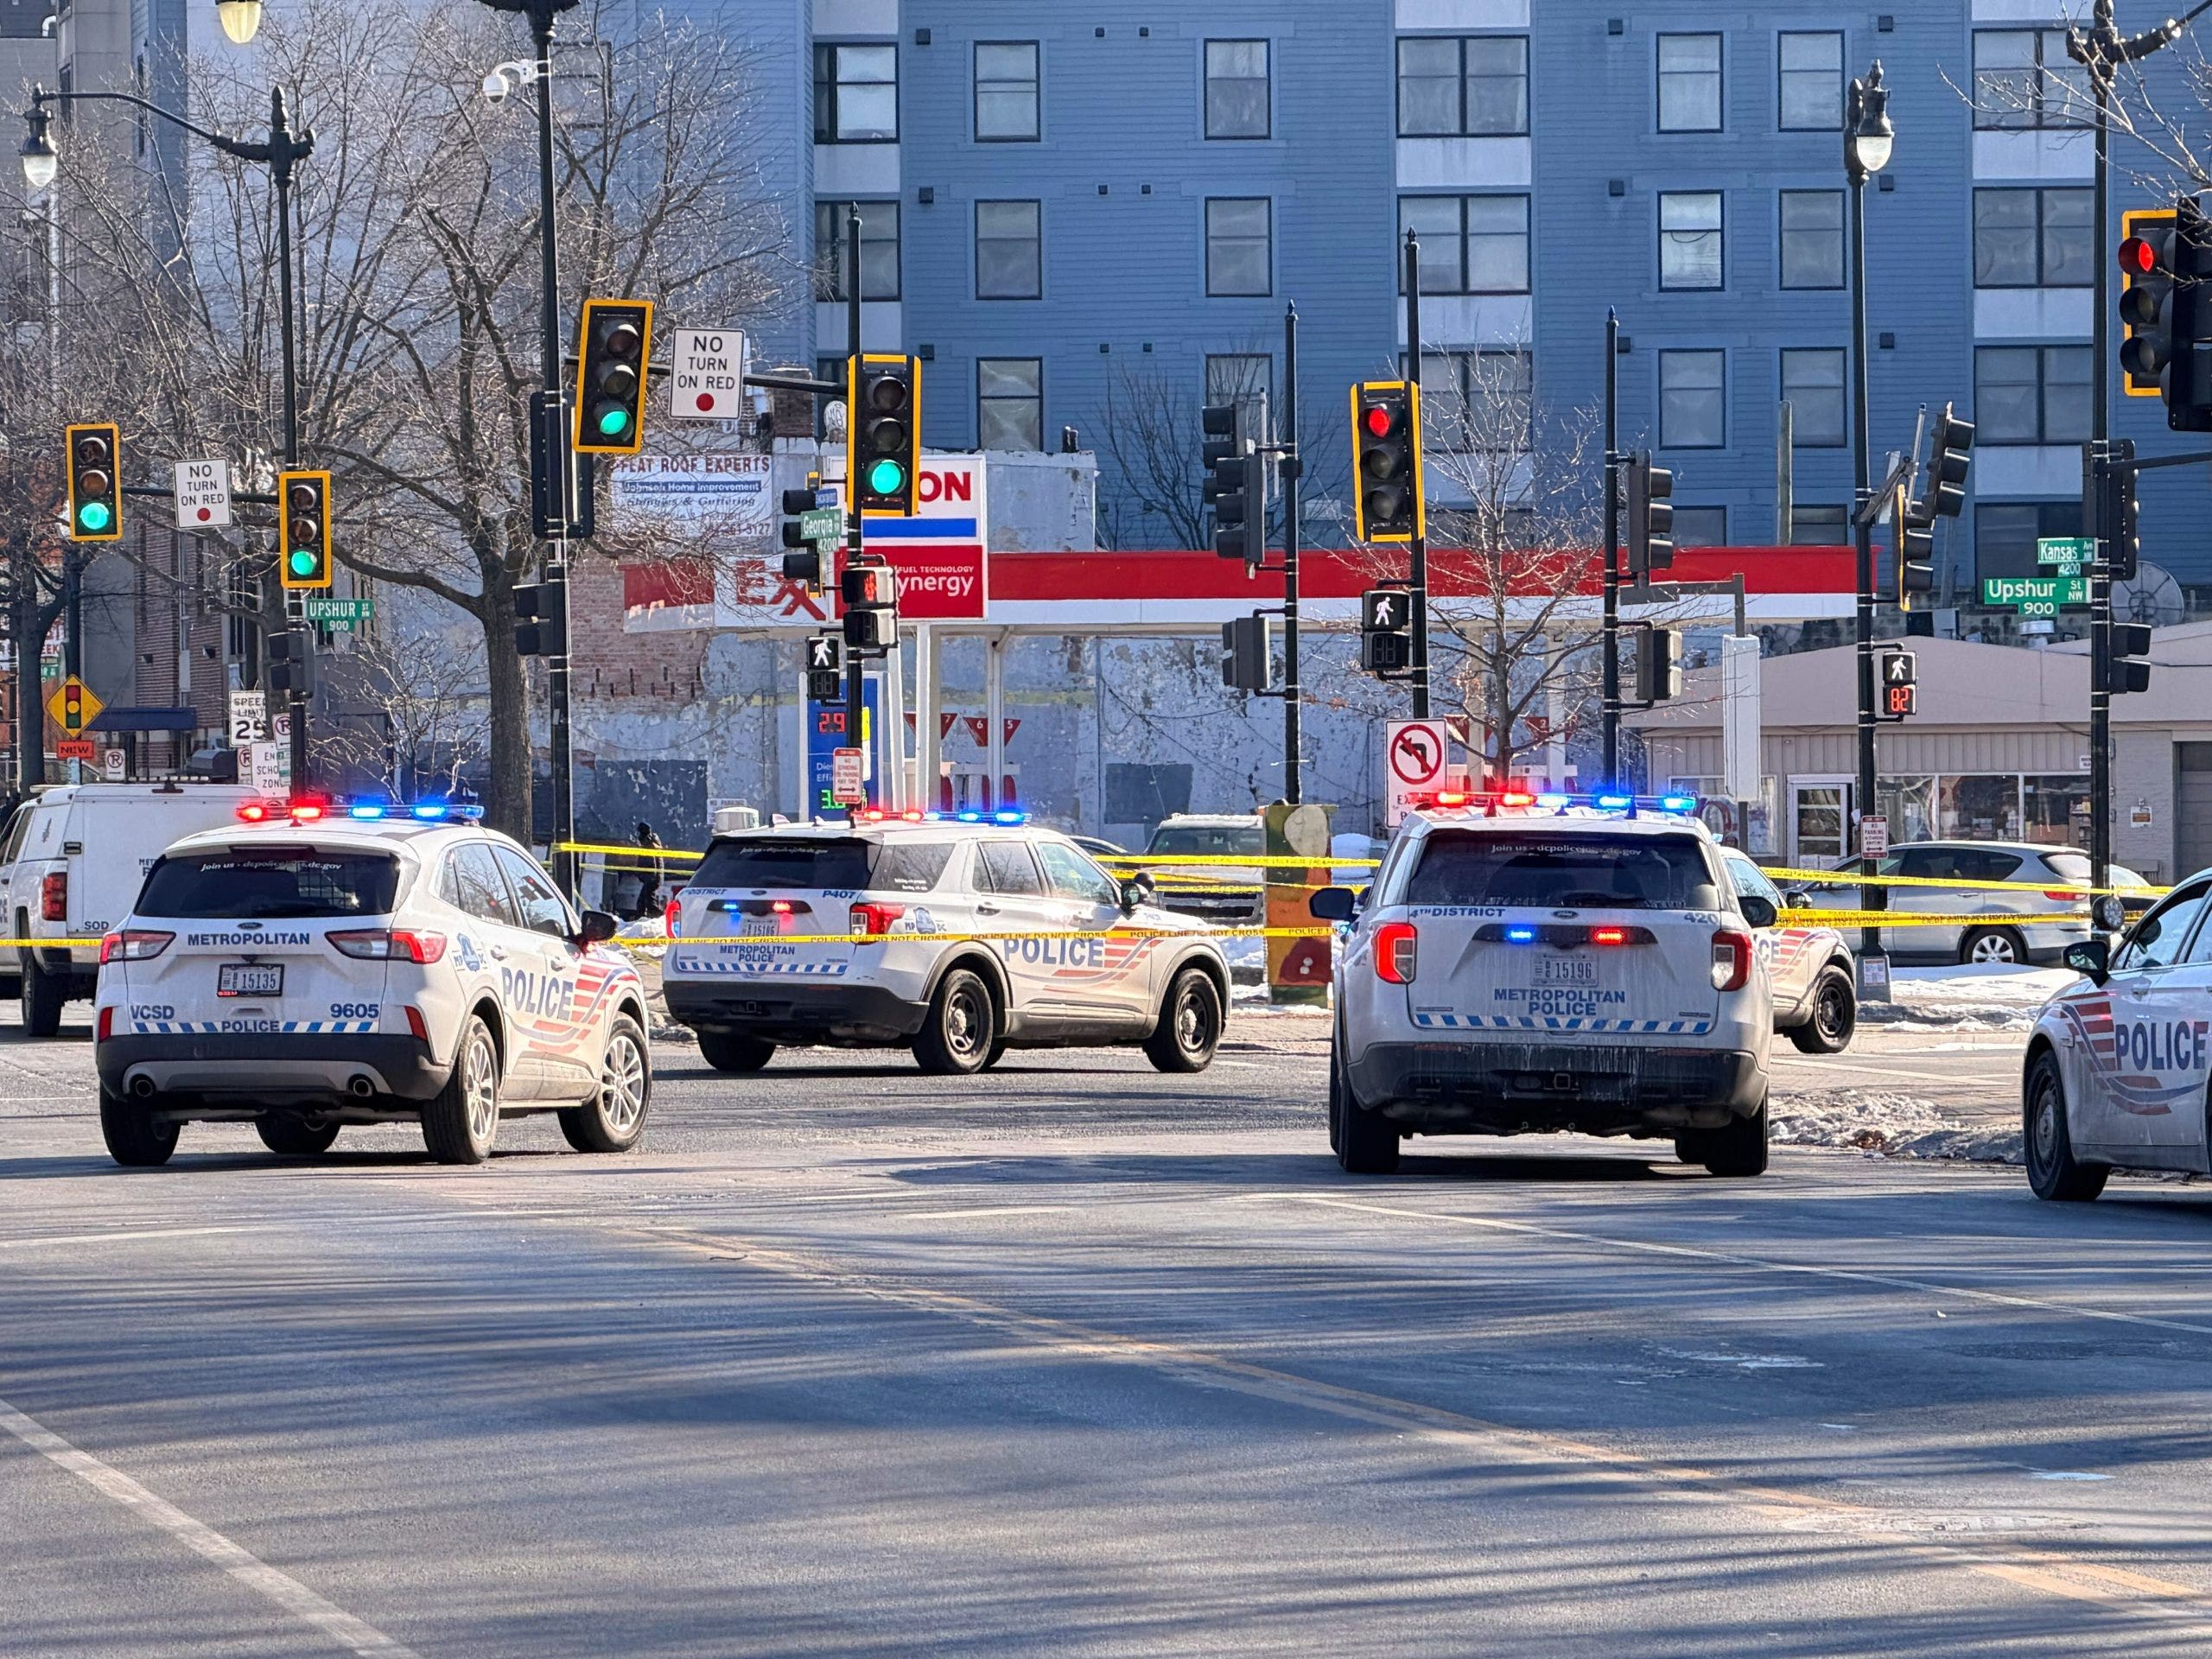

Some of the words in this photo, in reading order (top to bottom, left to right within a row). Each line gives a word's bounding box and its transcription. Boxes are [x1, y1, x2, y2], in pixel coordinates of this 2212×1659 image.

[693, 336, 723, 353] NO
[687, 356, 728, 372] TURN
[677, 374, 700, 389] ON
[706, 376, 735, 390] RED
[189, 464, 213, 478] NO
[620, 457, 658, 473] FLAT
[661, 457, 698, 473] ROOF
[705, 456, 770, 473] EXPERTS
[187, 480, 218, 492] TURN
[668, 482, 696, 493] Home
[696, 481, 760, 493] Improvement
[181, 494, 197, 506] ON
[202, 493, 225, 505] RED
[803, 513, 833, 537] Georgia
[817, 537, 837, 551] 4200
[2040, 542, 2078, 561] Kansas
[920, 565, 974, 574] TECHNOLOGY
[2058, 563, 2082, 575] 4200
[899, 575, 974, 597] ynergy
[1988, 579, 2056, 603] Upshur
[2070, 580, 2082, 590] St
[2068, 591, 2083, 601] NW
[308, 601, 356, 618] UPSHUR
[2024, 601, 2055, 615] 900
[328, 620, 349, 632] 900
[1891, 688, 1909, 712] 82
[818, 712, 847, 734] 2.9
[976, 720, 984, 730] 6
[1007, 720, 1014, 730] 5
[60, 746, 89, 754] NEW
[264, 752, 276, 761] EN
[257, 766, 279, 775] SCHO
[816, 762, 834, 771] Die
[1491, 844, 1513, 854] Join
[200, 863, 220, 872] Join
[242, 860, 342, 871] dcpolij.dc.gov
[822, 890, 856, 899] P407
[1432, 907, 1506, 918] DISTRICT
[1683, 912, 1719, 925] 420
[84, 920, 110, 930] SOD
[187, 932, 311, 946] METROPOLITAN
[970, 931, 1007, 940] POLICE
[719, 945, 796, 955] METROPOLITAN
[1002, 938, 1105, 968] POLICE
[738, 953, 774, 963] POLICE
[1555, 962, 1592, 979] 15196
[242, 973, 276, 989] 15135
[500, 966, 575, 1021] POLICE
[1493, 988, 1626, 1003] METROPOLITAN
[130, 1004, 175, 1020] VCSD
[330, 1002, 380, 1020] 9605
[1528, 1001, 1597, 1016] POLICE
[221, 1020, 281, 1033] POLICE
[2115, 1020, 2209, 1071] POLICE
